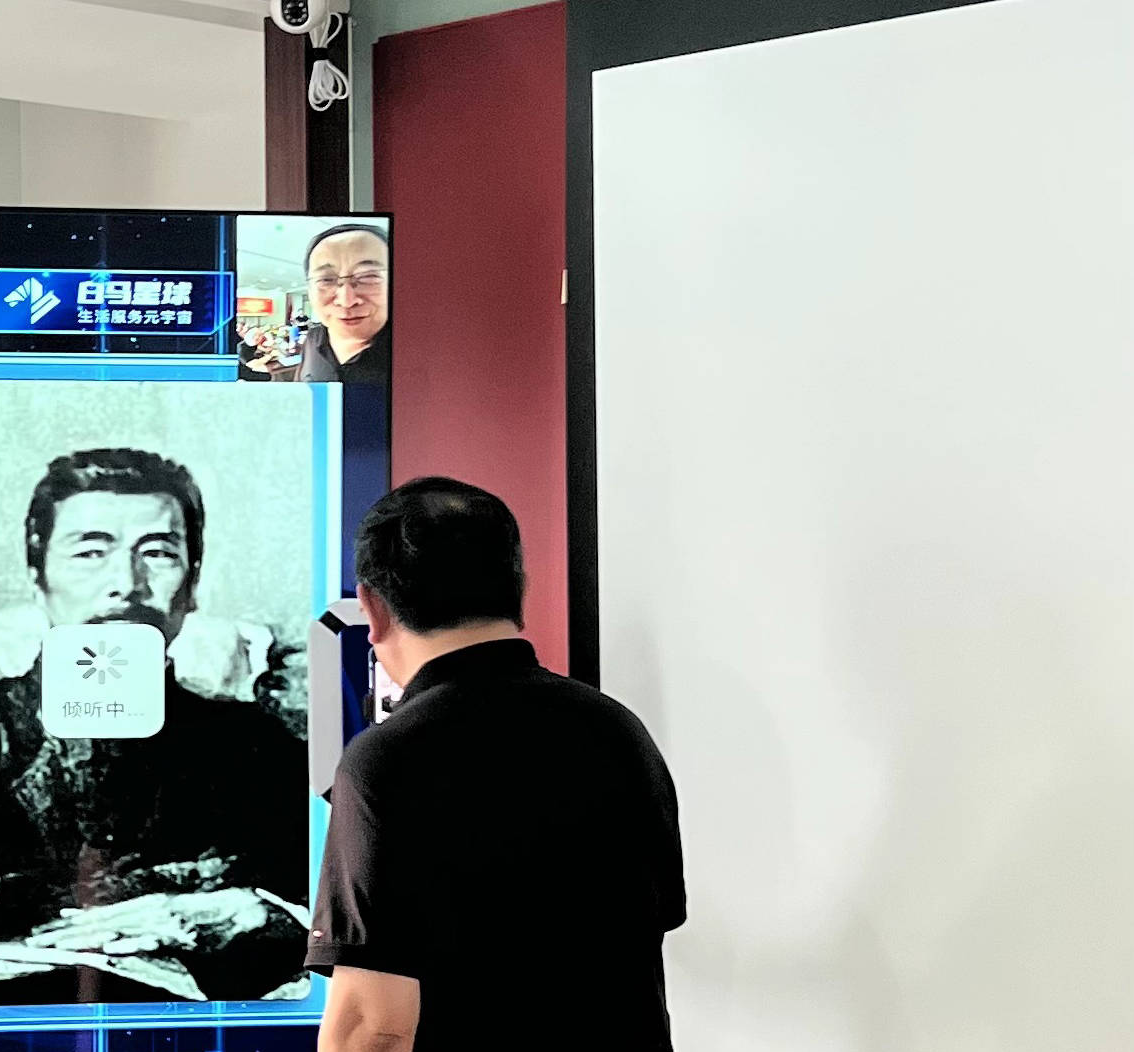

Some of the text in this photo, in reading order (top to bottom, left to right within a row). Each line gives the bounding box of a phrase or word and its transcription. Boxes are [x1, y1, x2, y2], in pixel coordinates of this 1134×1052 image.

[76, 280, 193, 306] 白马星球
[77, 308, 193, 325] 生活服务元宇宙
